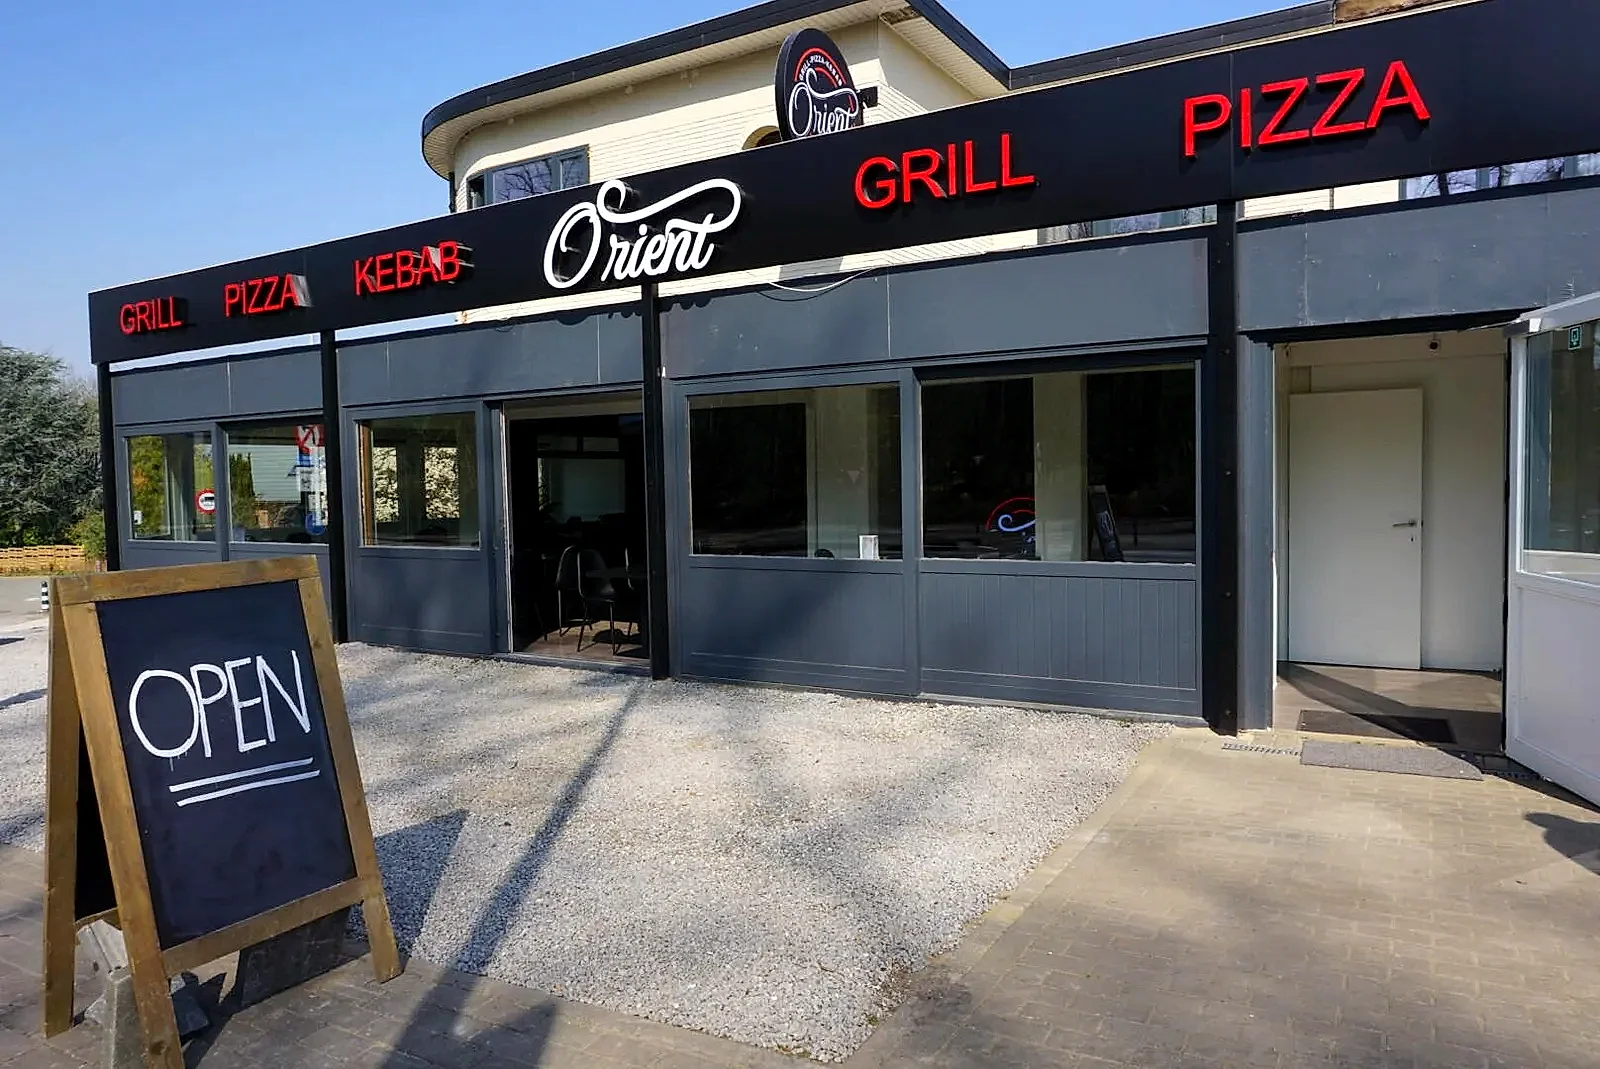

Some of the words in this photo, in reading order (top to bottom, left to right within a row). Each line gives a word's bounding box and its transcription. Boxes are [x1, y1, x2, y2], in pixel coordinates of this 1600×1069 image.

[788, 67, 860, 137] Orient
[120, 297, 183, 335] GRILL
[224, 273, 301, 317] PIZZA
[354, 240, 462, 296] KEBAB
[543, 178, 742, 289] Orient
[854, 133, 1035, 209] GRILL
[1183, 60, 1431, 157] PIZZA
[129, 650, 312, 759] OPEN
